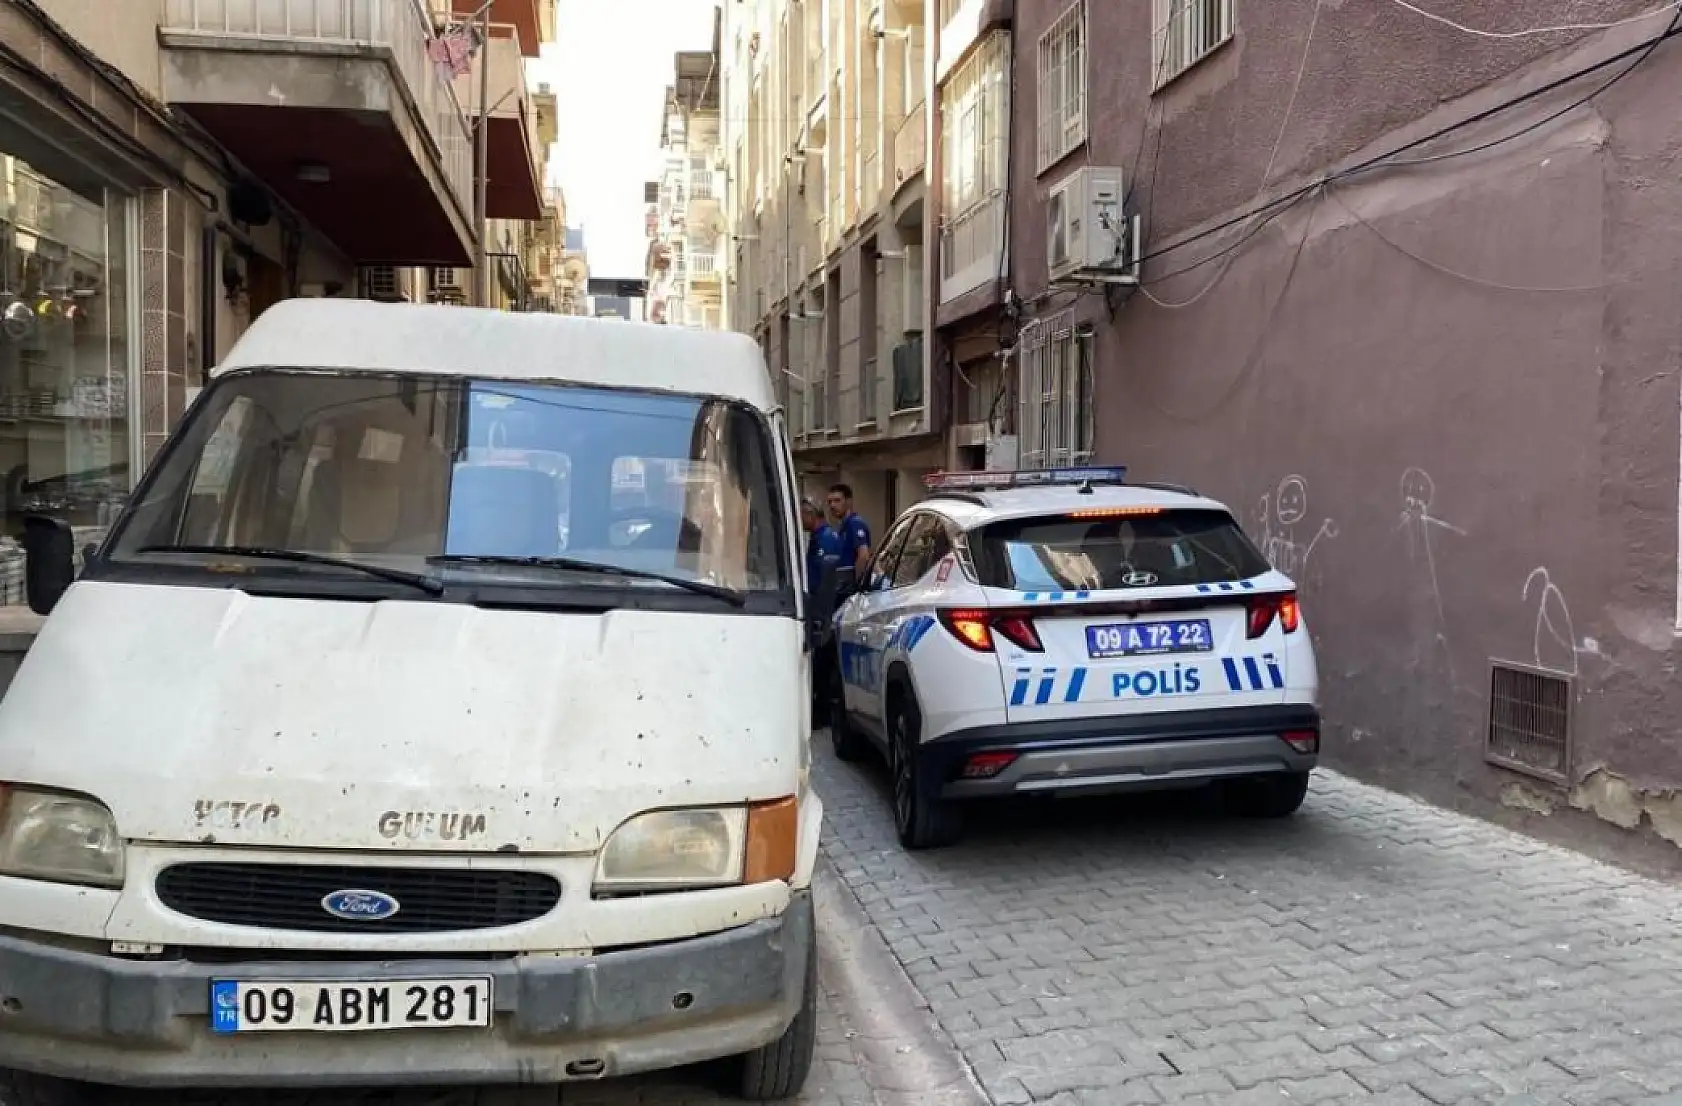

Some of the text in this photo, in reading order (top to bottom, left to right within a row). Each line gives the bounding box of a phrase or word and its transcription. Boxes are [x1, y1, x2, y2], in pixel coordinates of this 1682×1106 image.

[1096, 623, 1204, 650] 09 A 72 22
[1112, 662, 1201, 697] POLİS
[339, 895, 383, 914] Ford
[218, 984, 478, 1025] TR 09 ABM 281
